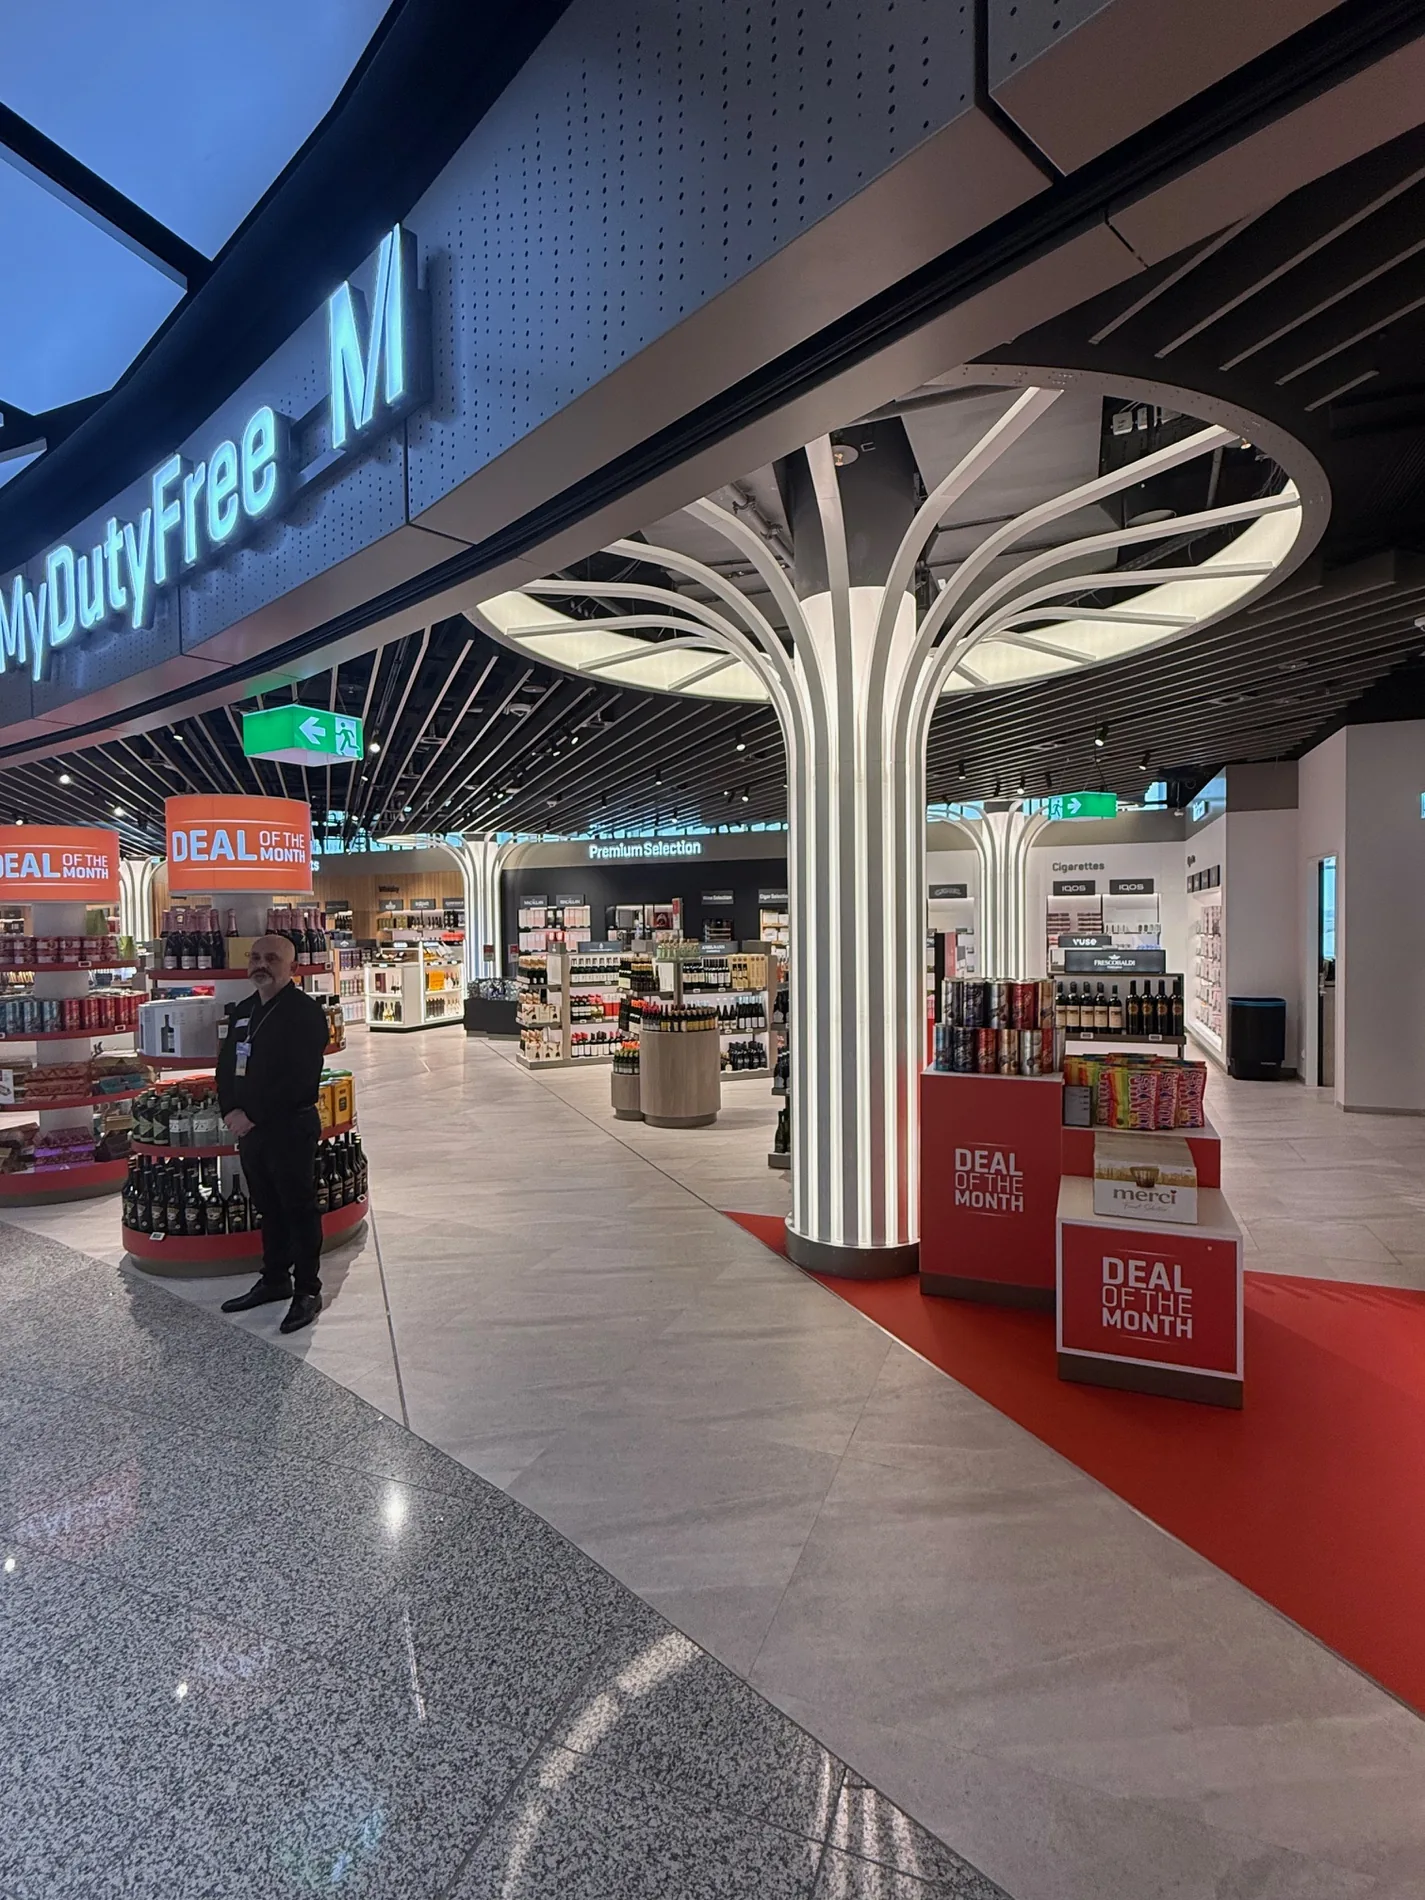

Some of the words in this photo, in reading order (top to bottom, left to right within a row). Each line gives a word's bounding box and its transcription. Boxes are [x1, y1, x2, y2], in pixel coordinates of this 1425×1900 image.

[329, 223, 403, 450] M
[0, 405, 278, 682] MyDutyFree
[172, 829, 258, 862] DEAL
[260, 830, 280, 846] OF
[283, 832, 305, 848] THE
[589, 843, 643, 859] Premium
[644, 840, 702, 856] Selection
[0, 853, 61, 878] EAL
[62, 853, 82, 866] OF
[85, 854, 108, 867] THE
[260, 847, 306, 863] MONTH
[63, 867, 109, 879] MONTH
[1052, 861, 1105, 873] Cigarettes
[1118, 883, 1144, 891] IQOS
[1094, 959, 1136, 967] FRESCOBALDI
[955, 1148, 1023, 1176] DEAL
[955, 1171, 980, 1190] OF
[984, 1173, 1024, 1195] THE
[955, 1189, 1024, 1212] MONTH
[1113, 1188, 1177, 1204] merci
[1102, 1256, 1192, 1294] DEAL
[1102, 1285, 1136, 1308] OF
[1141, 1289, 1192, 1317] THE
[1102, 1307, 1192, 1339] MONTH
